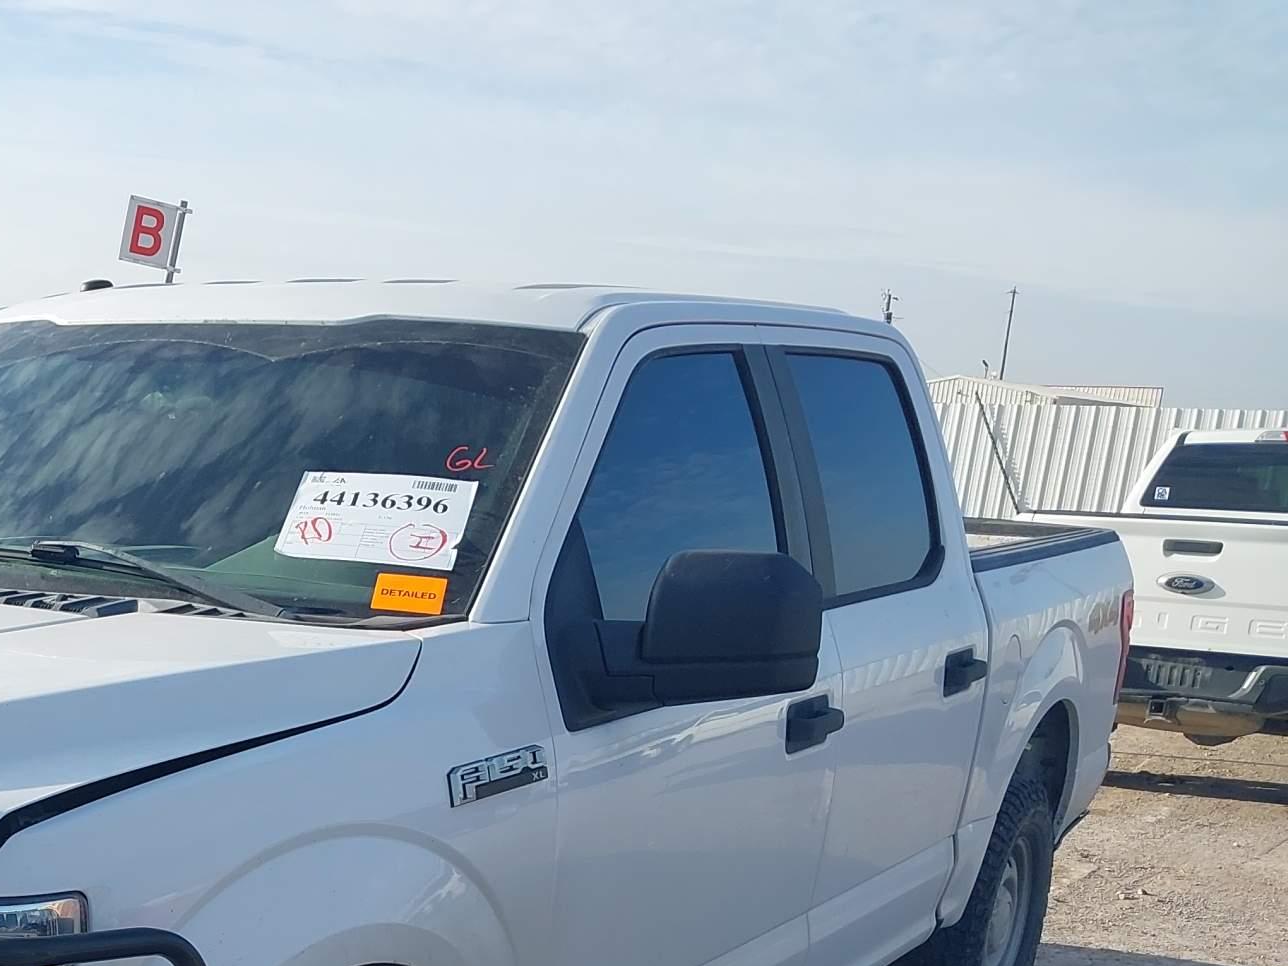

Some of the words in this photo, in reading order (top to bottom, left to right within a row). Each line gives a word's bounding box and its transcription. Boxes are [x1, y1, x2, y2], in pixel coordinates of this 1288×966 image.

[129, 204, 165, 257] B
[313, 490, 449, 514] 44136396
[380, 588, 437, 600] DETAILED
[532, 770, 546, 781] XL
